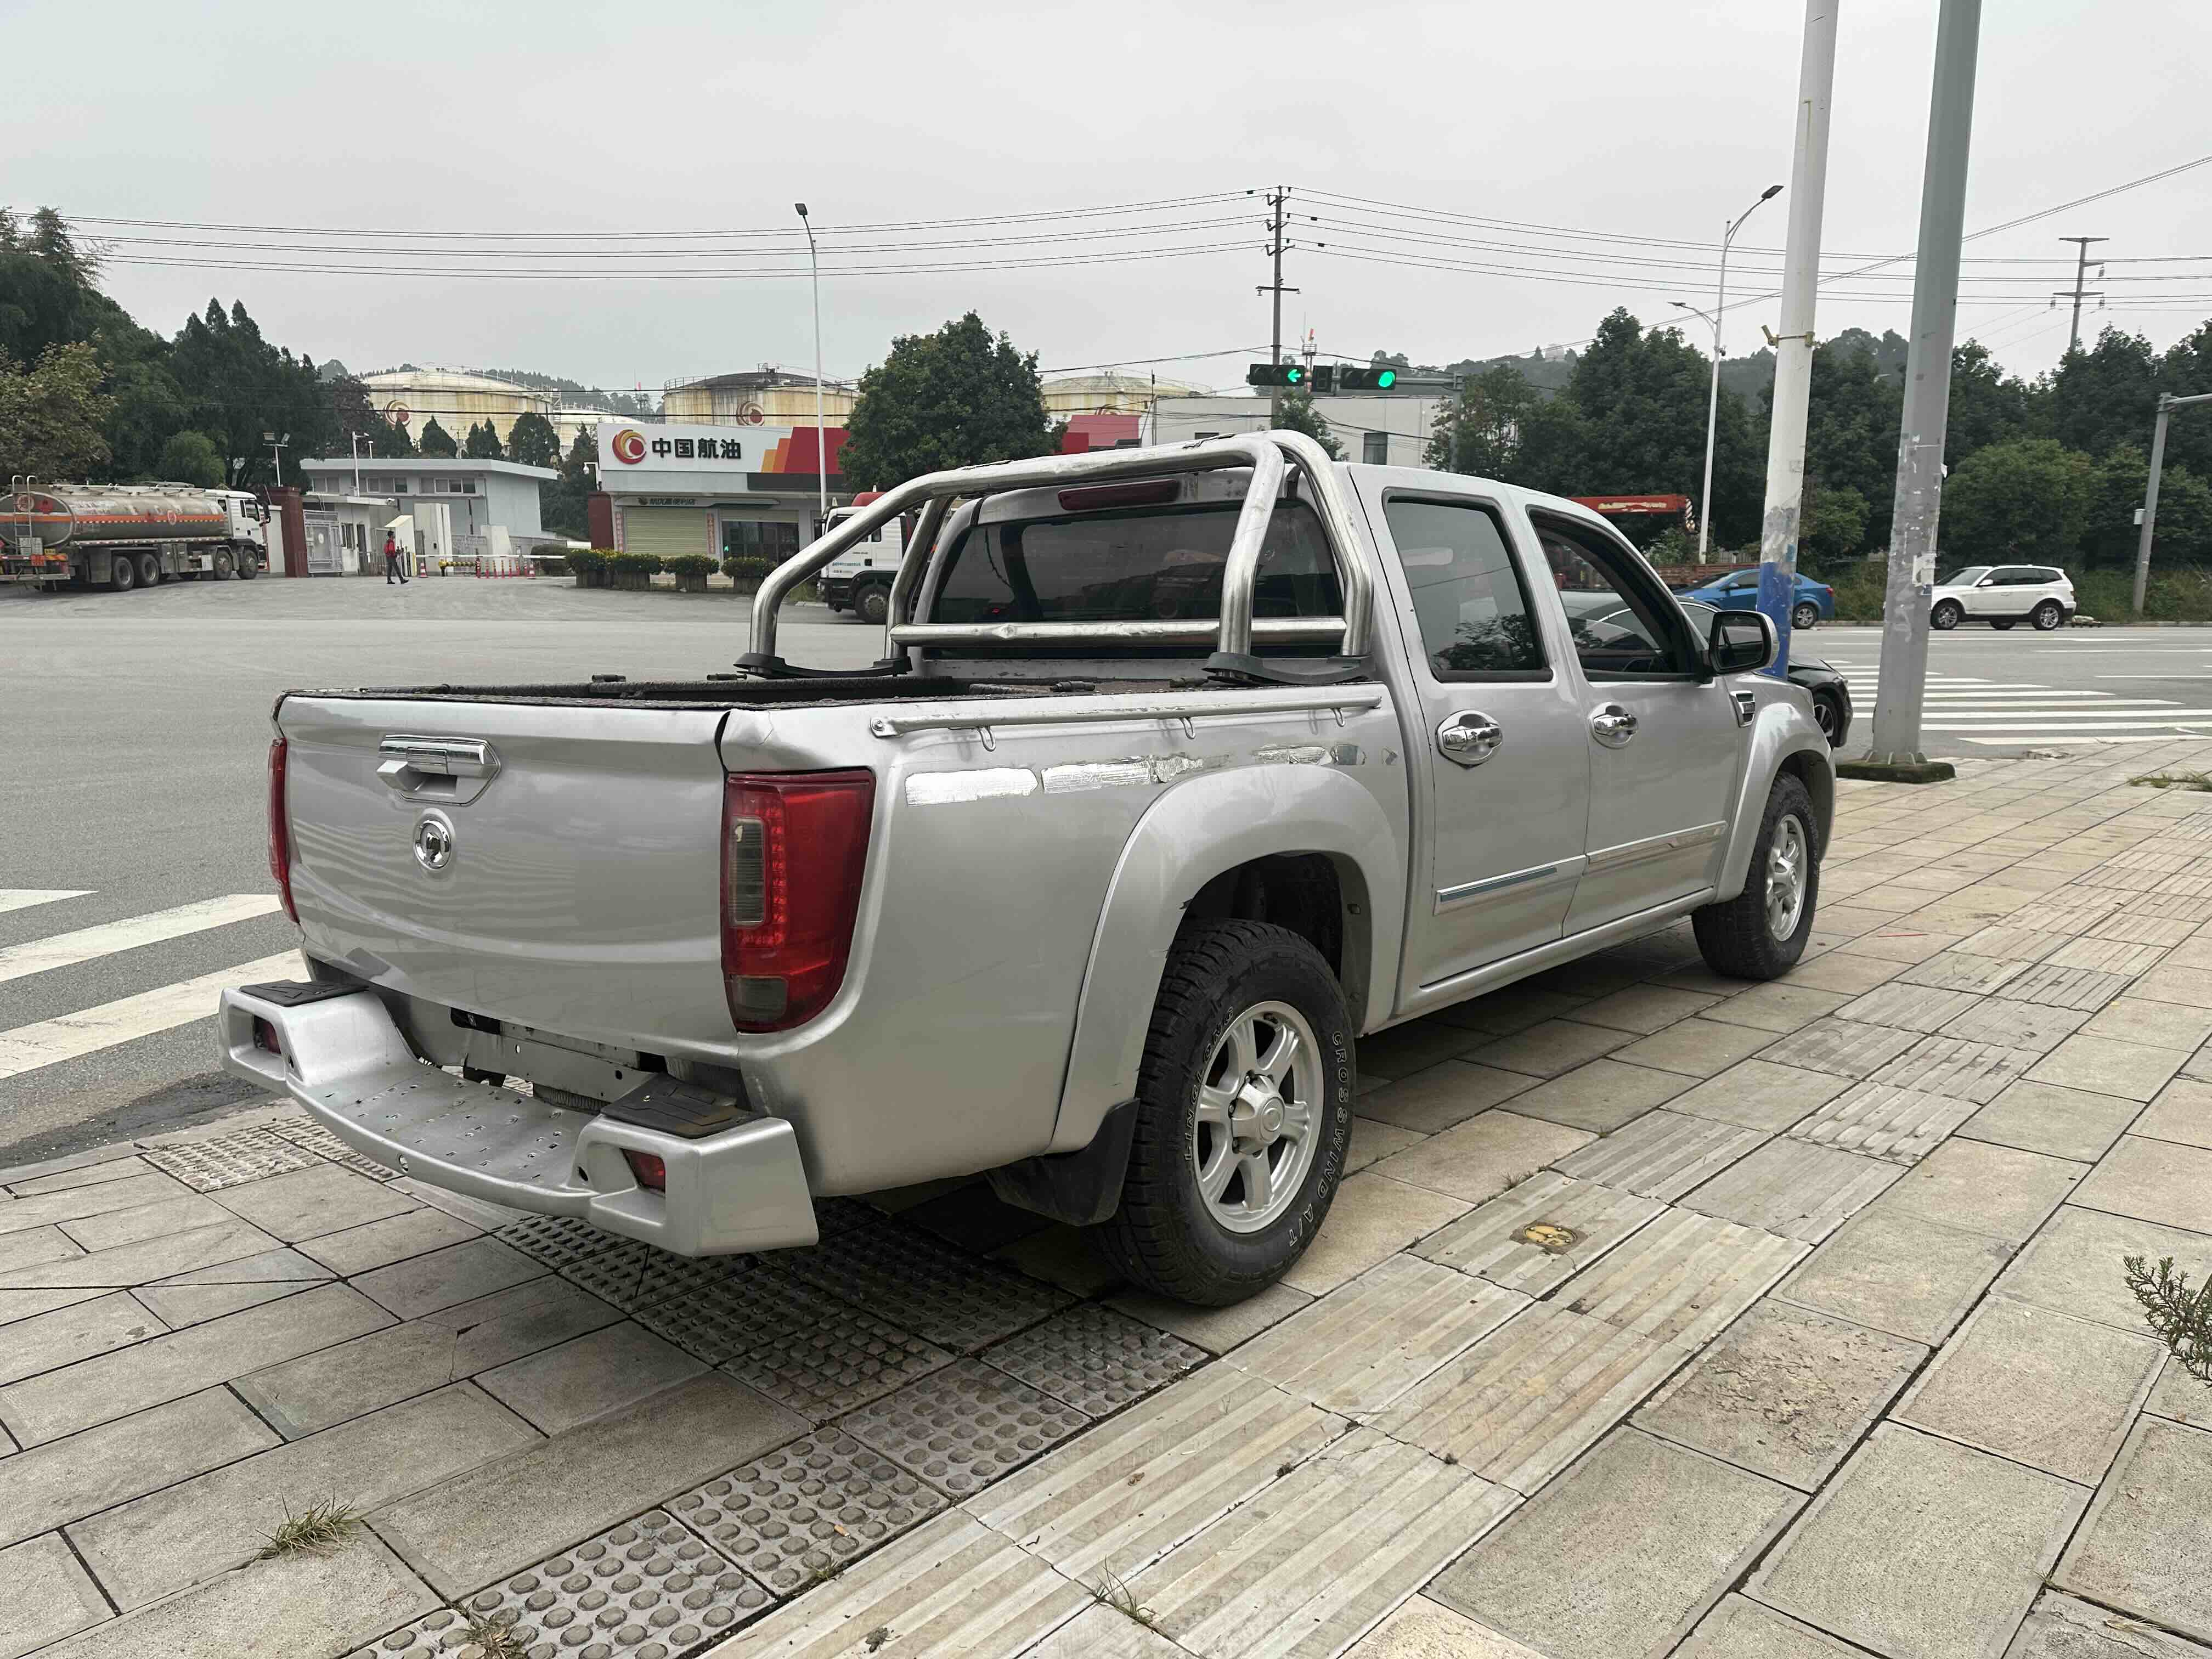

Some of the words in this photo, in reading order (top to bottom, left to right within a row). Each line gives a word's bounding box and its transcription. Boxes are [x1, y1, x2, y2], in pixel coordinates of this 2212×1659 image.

[652, 437, 741, 459] 中国航油
[1318, 1031, 1349, 1199] CROSSWIND
[1289, 1203, 1314, 1247] A/T
